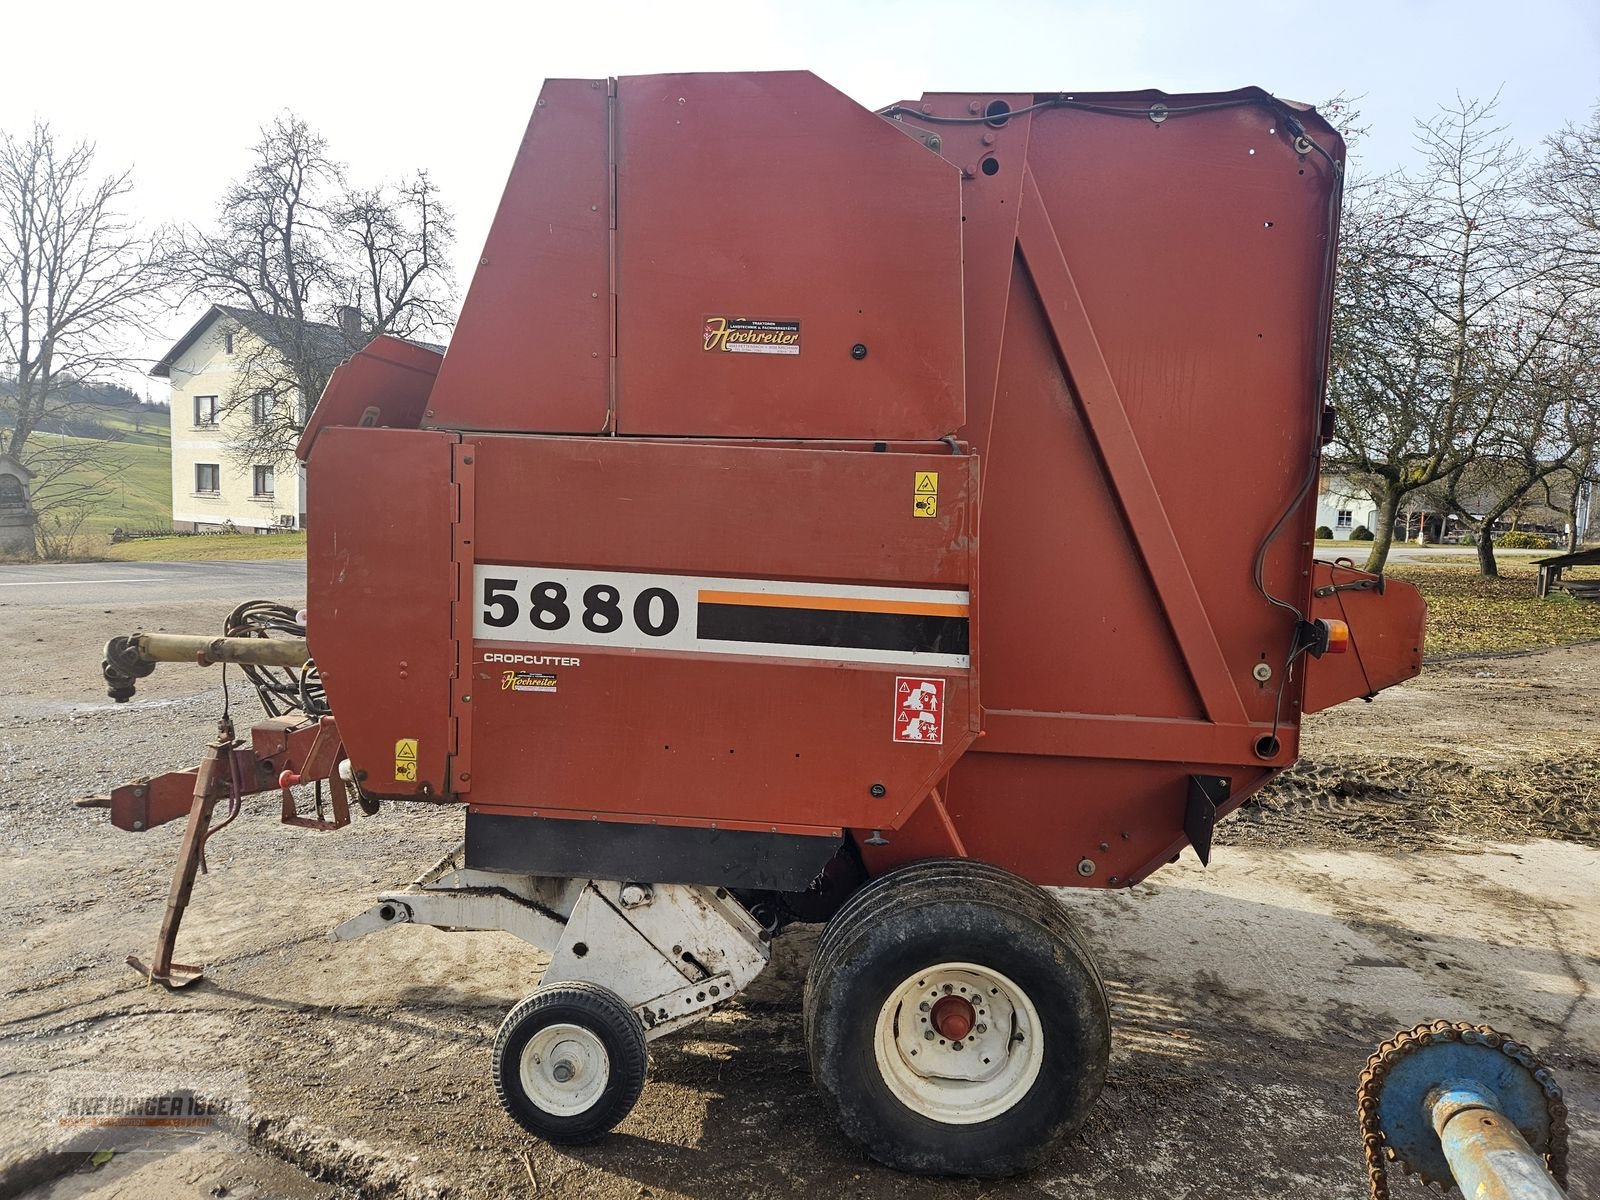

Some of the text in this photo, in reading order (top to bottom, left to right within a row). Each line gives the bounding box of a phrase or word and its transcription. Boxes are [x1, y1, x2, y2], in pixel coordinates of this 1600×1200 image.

[704, 317, 799, 351] Hochreiter
[483, 577, 680, 637] 5880
[483, 653, 580, 667] CROPCUTTER
[501, 670, 557, 691] Hochreiter
